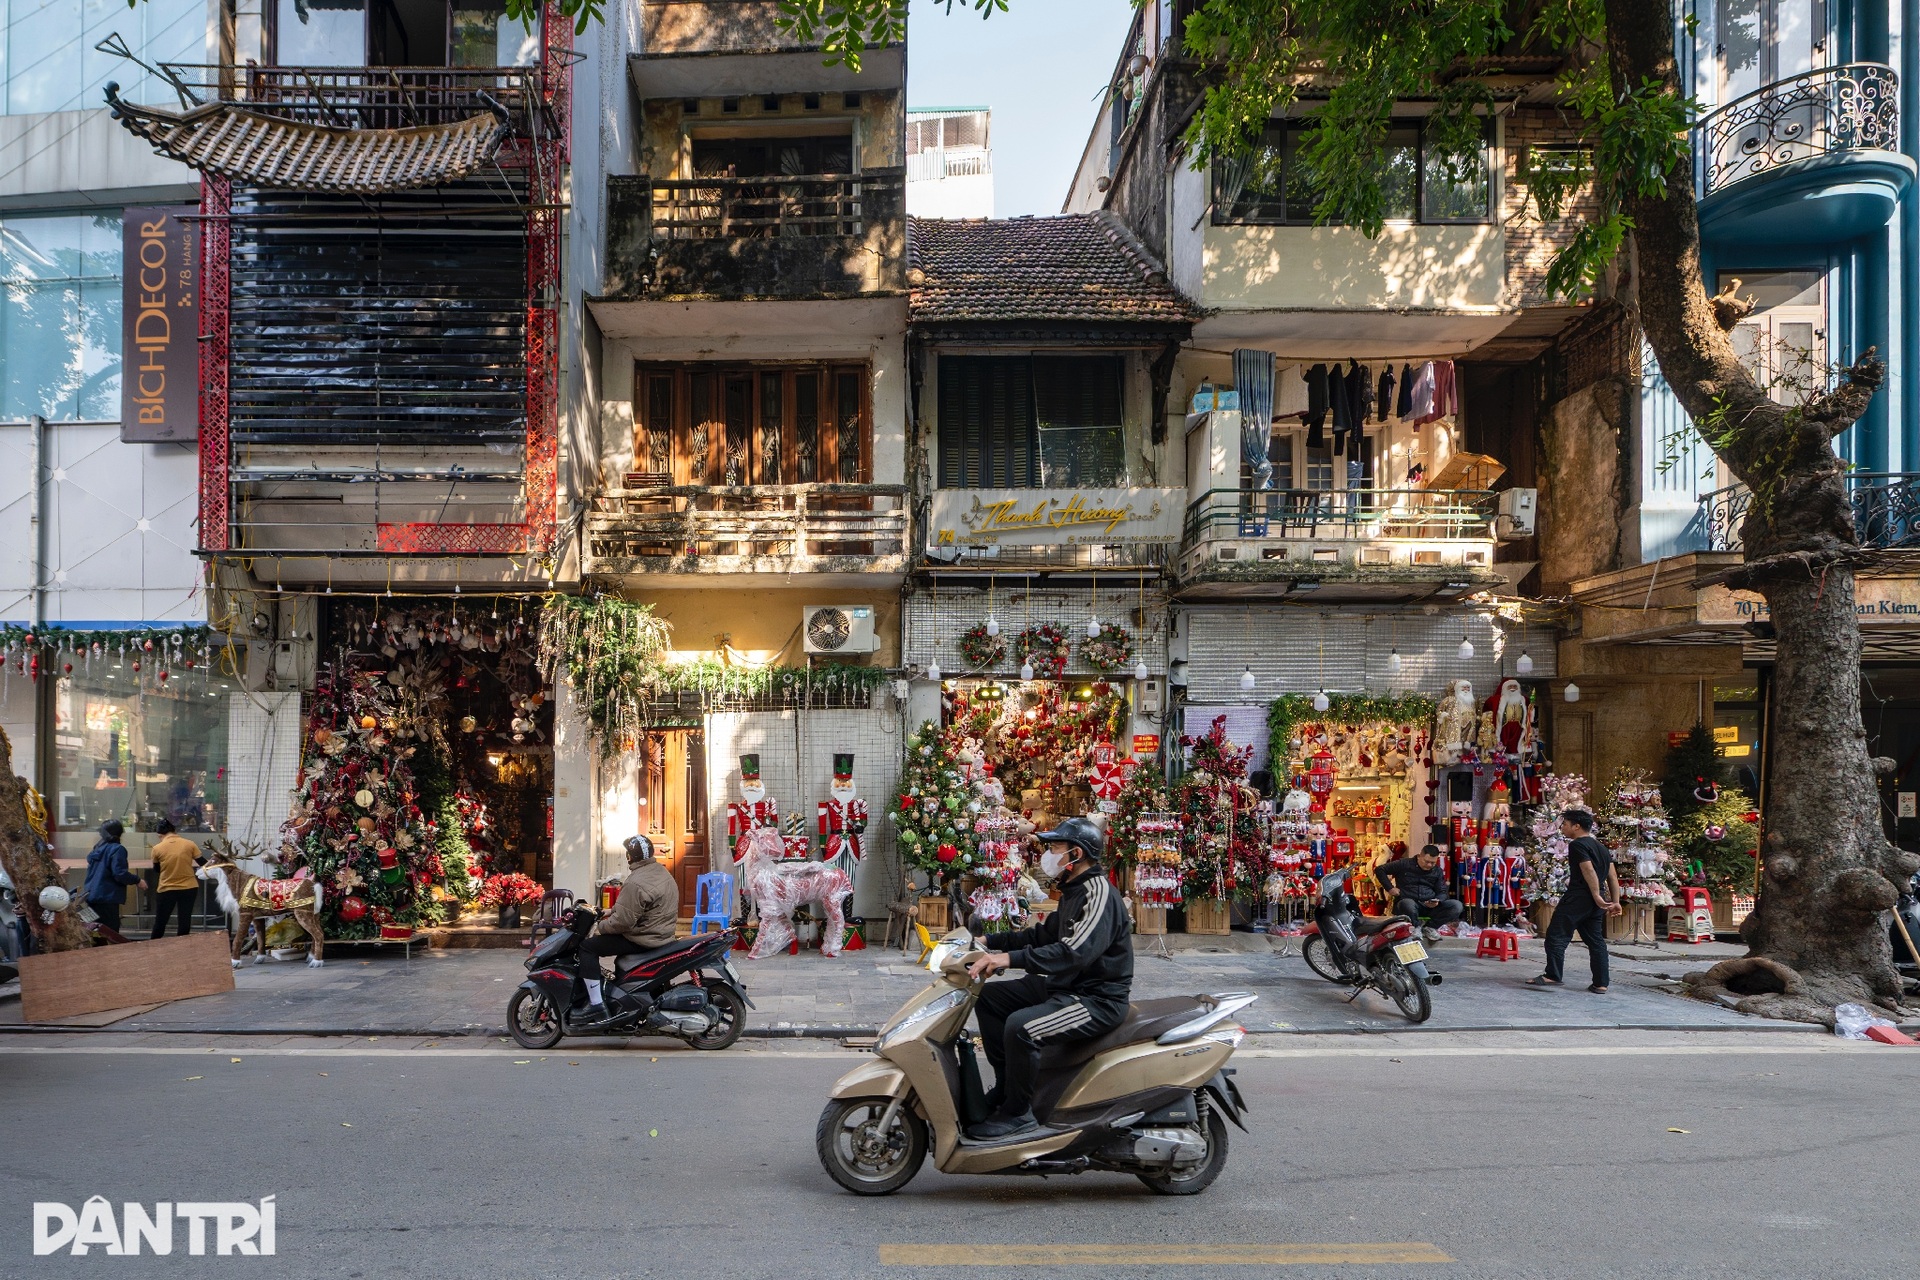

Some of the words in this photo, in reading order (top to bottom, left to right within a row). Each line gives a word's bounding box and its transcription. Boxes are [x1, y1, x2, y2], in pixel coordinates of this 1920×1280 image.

[180, 269, 192, 289] 78
[982, 500, 1048, 529] Thanh
[938, 530, 955, 544] 74
[1734, 601, 1752, 616] 70
